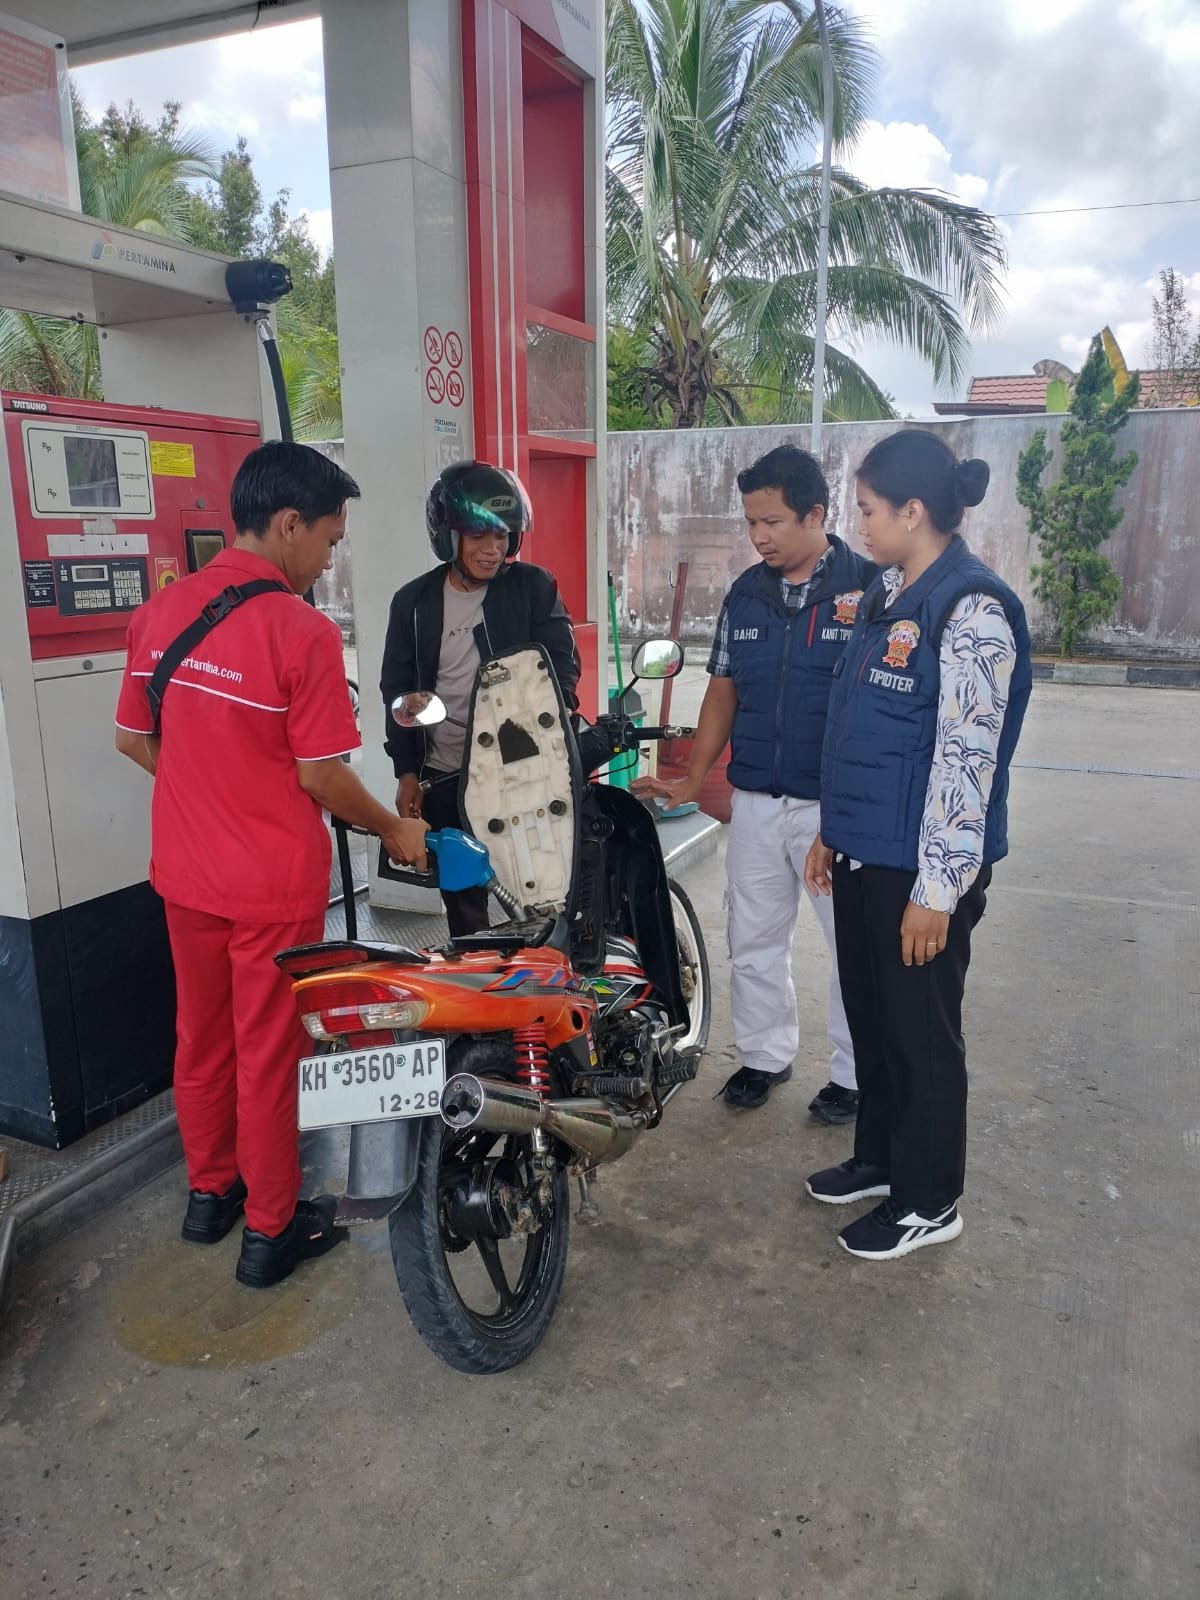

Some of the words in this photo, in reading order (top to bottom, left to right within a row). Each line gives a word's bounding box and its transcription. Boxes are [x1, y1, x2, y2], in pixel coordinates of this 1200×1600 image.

[118, 247, 177, 274] PERTAMINA
[12, 400, 47, 411] TATSUNO
[41, 442, 52, 454] Rp
[47, 488, 57, 499] Rp
[491, 499, 512, 507] GM
[448, 627, 470, 638] ATT
[733, 628, 759, 641] BAHO
[821, 627, 839, 640] KANIT
[868, 668, 914, 693] TIPIDTER
[302, 1061, 327, 1091] KH
[341, 1052, 395, 1086] 3560
[412, 1046, 439, 1078] AP
